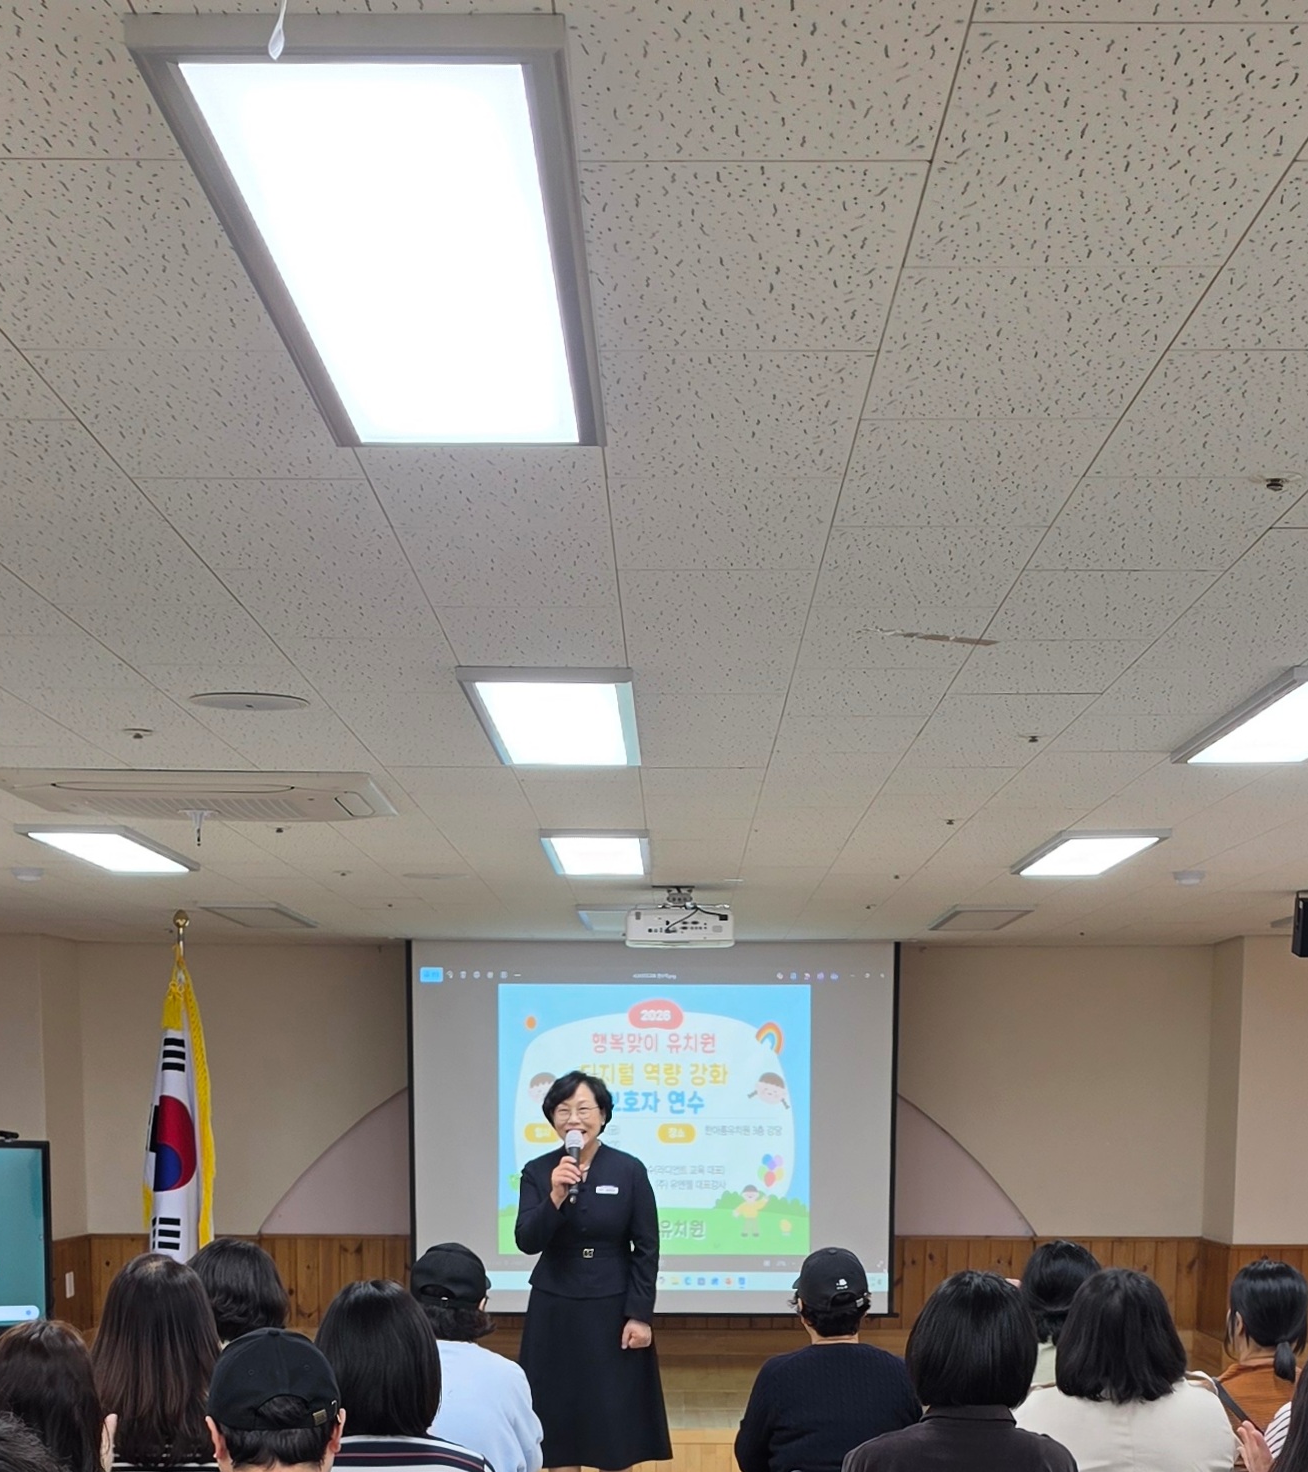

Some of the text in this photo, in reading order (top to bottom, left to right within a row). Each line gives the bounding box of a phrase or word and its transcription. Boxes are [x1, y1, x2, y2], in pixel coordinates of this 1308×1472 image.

[592, 1033, 716, 1053] 행복맞이 유치원
[643, 1063, 681, 1087] 역량
[690, 1063, 728, 1087] 강화
[667, 1090, 705, 1114] 연수
